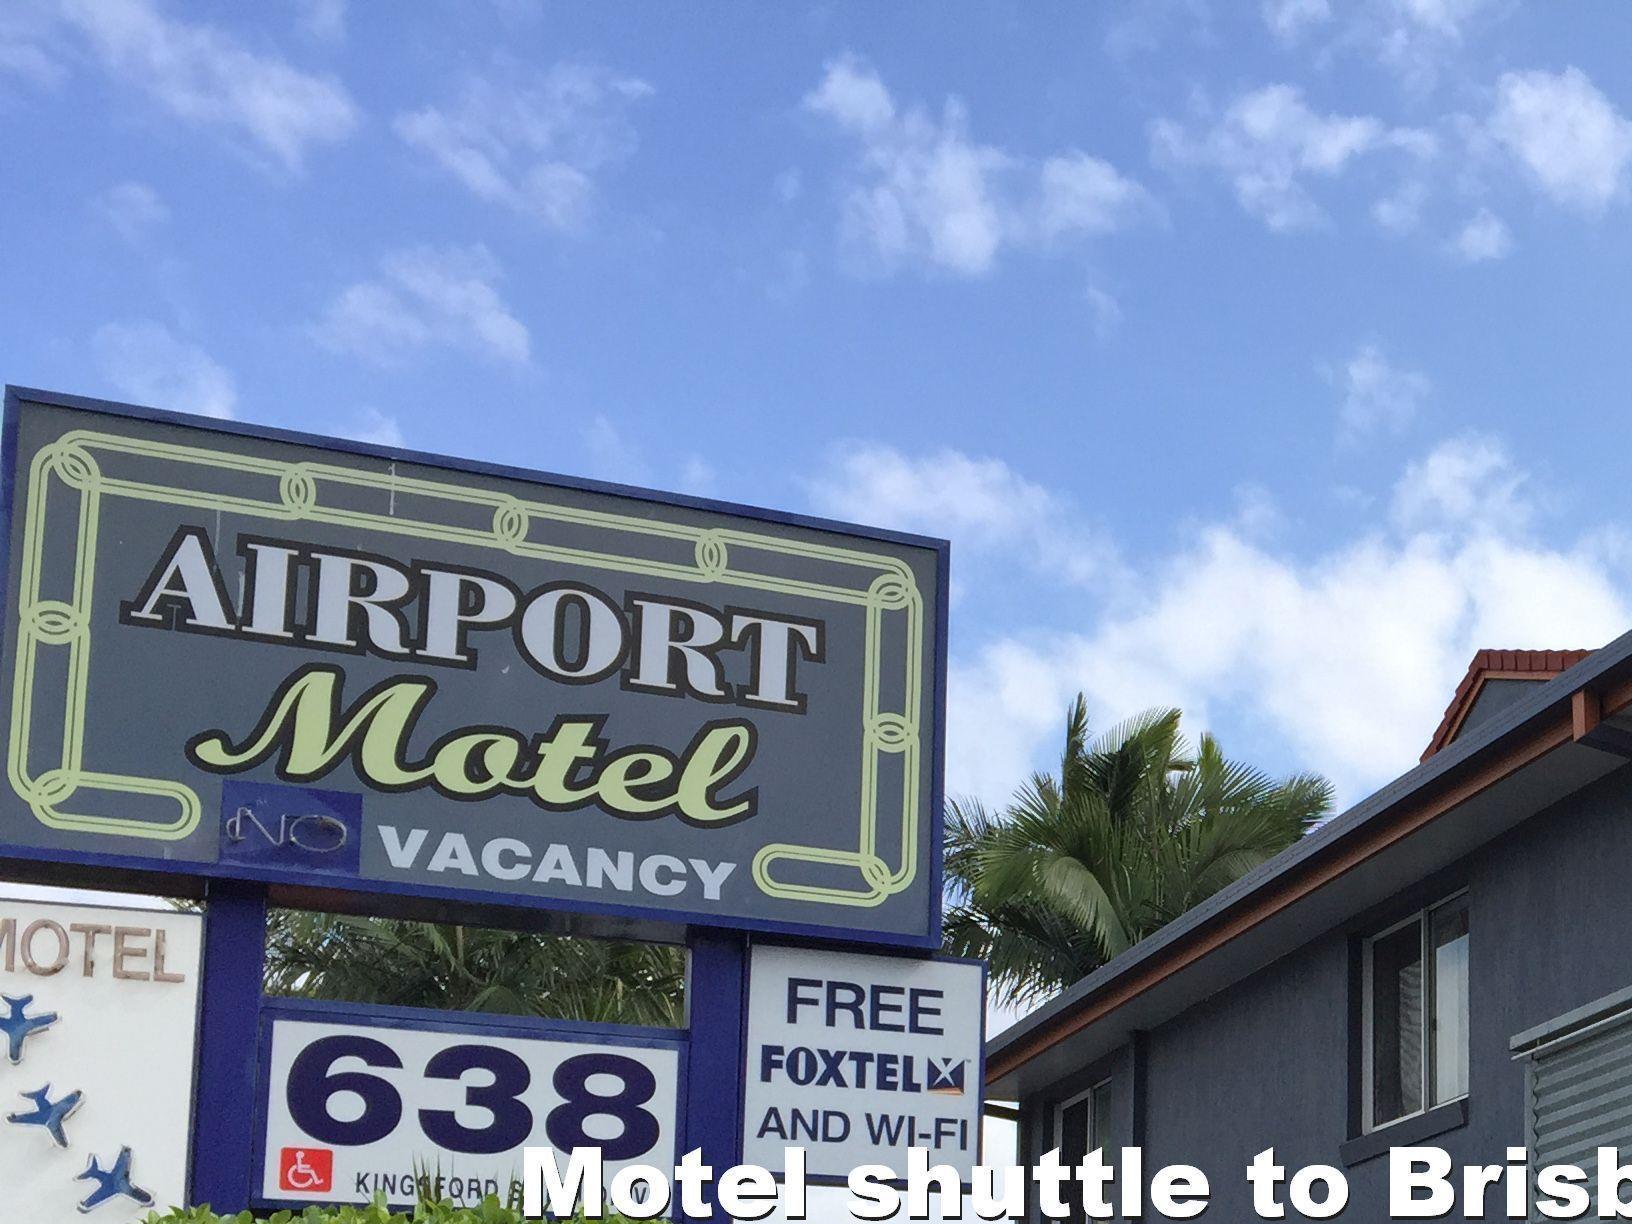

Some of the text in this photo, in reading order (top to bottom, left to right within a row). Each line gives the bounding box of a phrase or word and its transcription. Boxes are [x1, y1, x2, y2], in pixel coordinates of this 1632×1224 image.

[122, 525, 824, 713] AIRPORT
[186, 663, 757, 827] Motel
[225, 806, 738, 901] NO VACANCY
[786, 976, 945, 1037] FREE
[285, 1034, 661, 1162] 638
[760, 1043, 922, 1094] FOXTEL
[755, 1105, 969, 1151] AND WI-FI
[355, 1171, 499, 1201] KINGFORD
